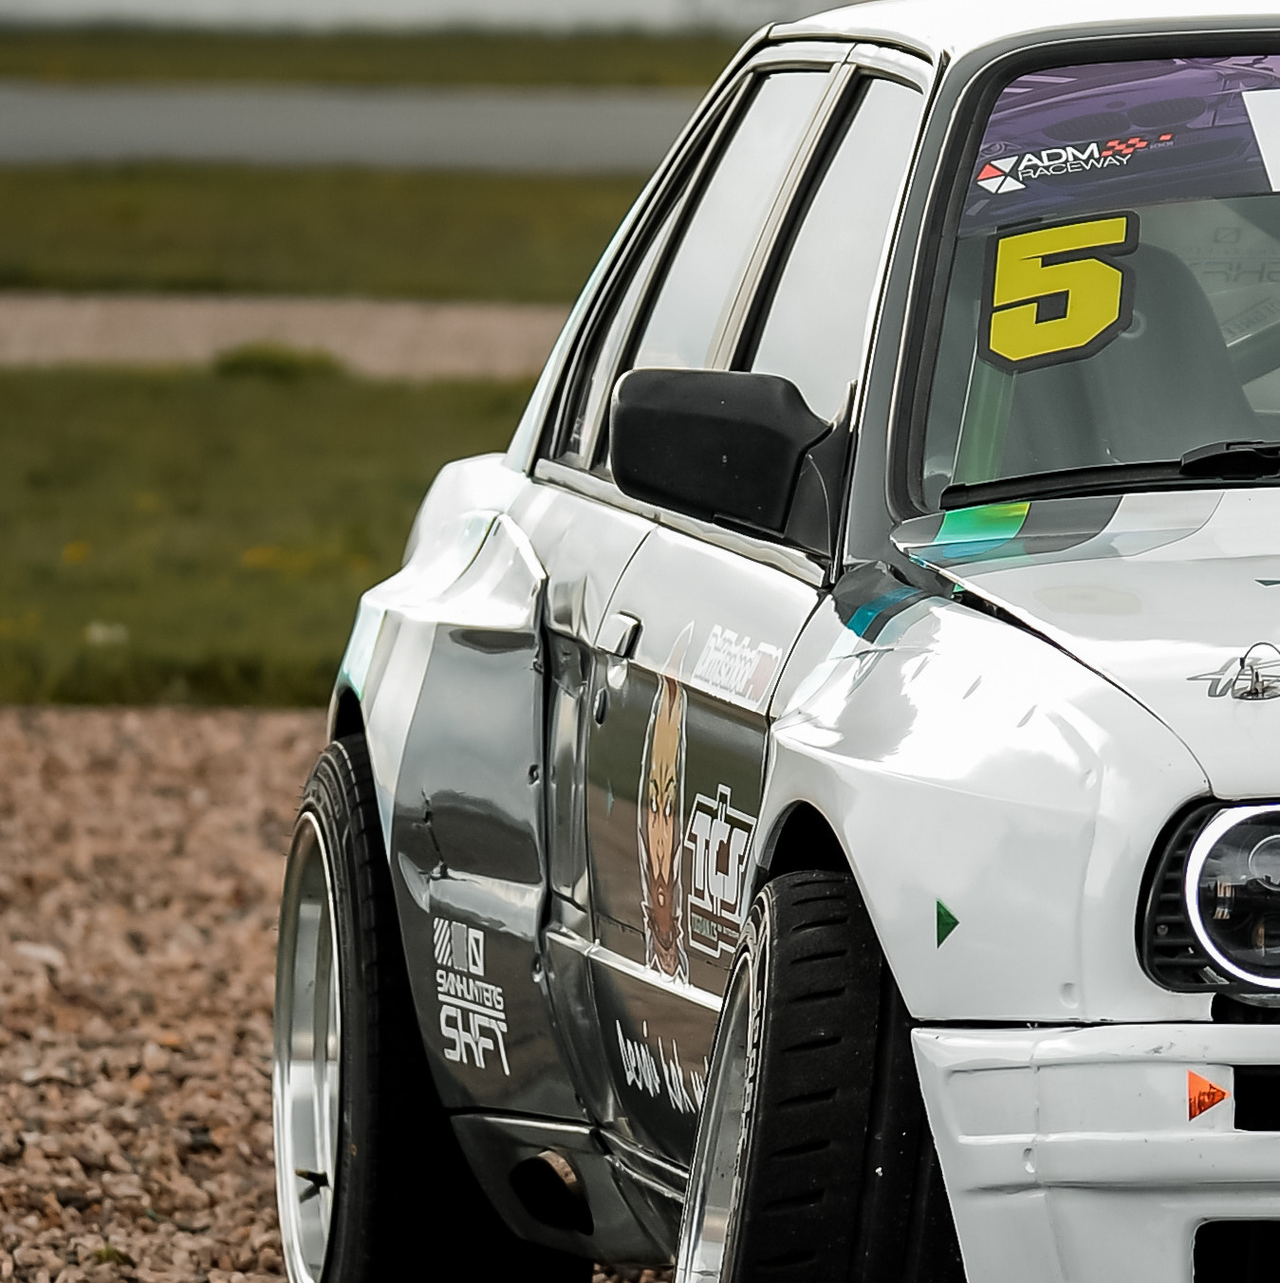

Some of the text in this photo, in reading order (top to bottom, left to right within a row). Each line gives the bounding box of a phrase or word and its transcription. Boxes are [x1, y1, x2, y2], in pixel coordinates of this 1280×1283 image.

[1017, 142, 1100, 171] ADM
[1018, 153, 1132, 182] RACEWAY
[988, 214, 1129, 363] 5
